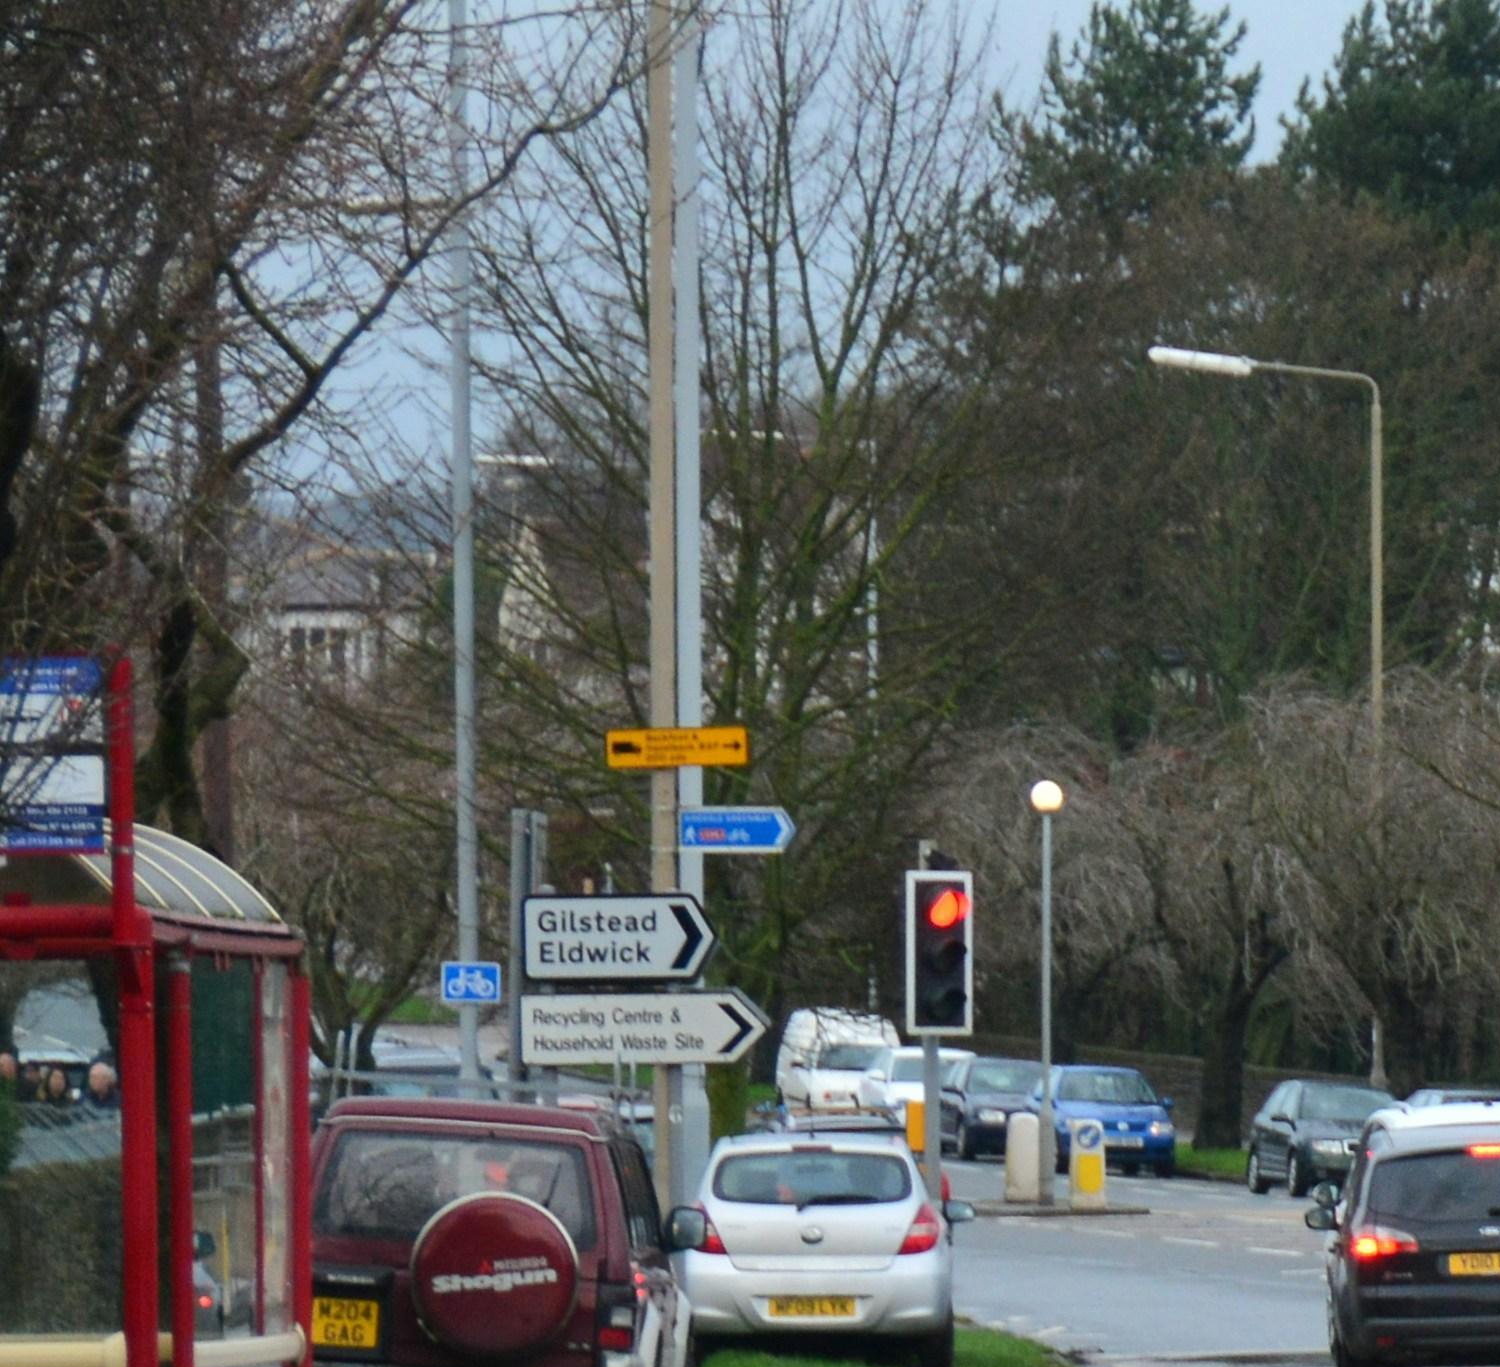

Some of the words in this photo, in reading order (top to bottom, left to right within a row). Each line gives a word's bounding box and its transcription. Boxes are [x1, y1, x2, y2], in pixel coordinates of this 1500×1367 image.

[537, 909, 657, 933] Gilstead
[539, 940, 651, 964] Eldwick
[532, 1007, 605, 1027] Recycling
[612, 1007, 663, 1023] Centre
[671, 1008, 681, 1022] &
[533, 1033, 613, 1051] Household
[619, 1034, 667, 1050] Waste
[675, 1034, 704, 1050] Site
[431, 1267, 558, 1294] Shogun
[323, 1323, 365, 1342] GAG
